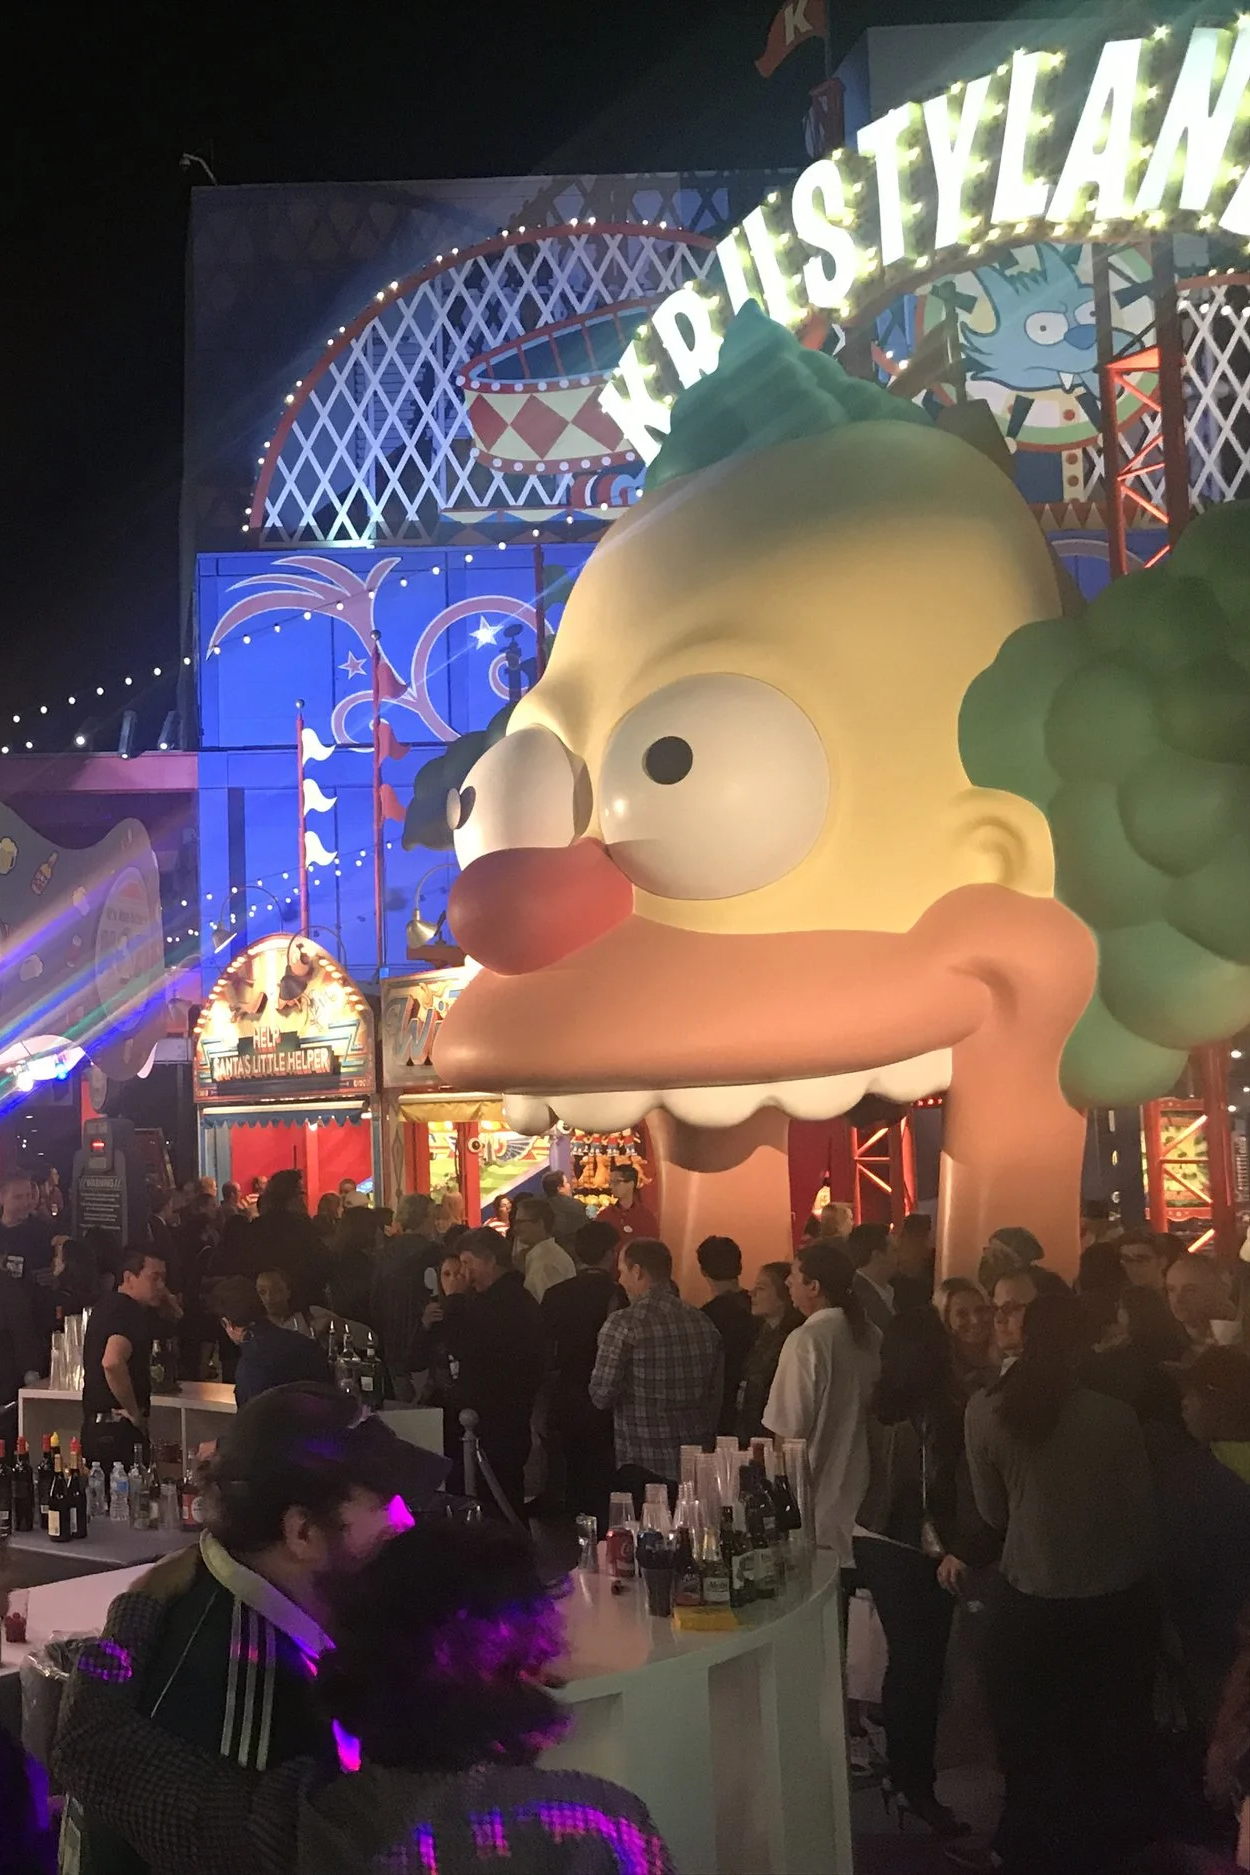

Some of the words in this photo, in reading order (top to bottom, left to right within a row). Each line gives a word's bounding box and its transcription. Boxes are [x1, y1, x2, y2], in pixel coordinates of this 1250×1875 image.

[598, 26, 1250, 467] KRUSTYLAN
[252, 1025, 282, 1051] HELP
[213, 1052, 250, 1079] SANTA'S
[252, 1050, 286, 1075] LITTLE
[287, 1047, 331, 1073] HELPER
